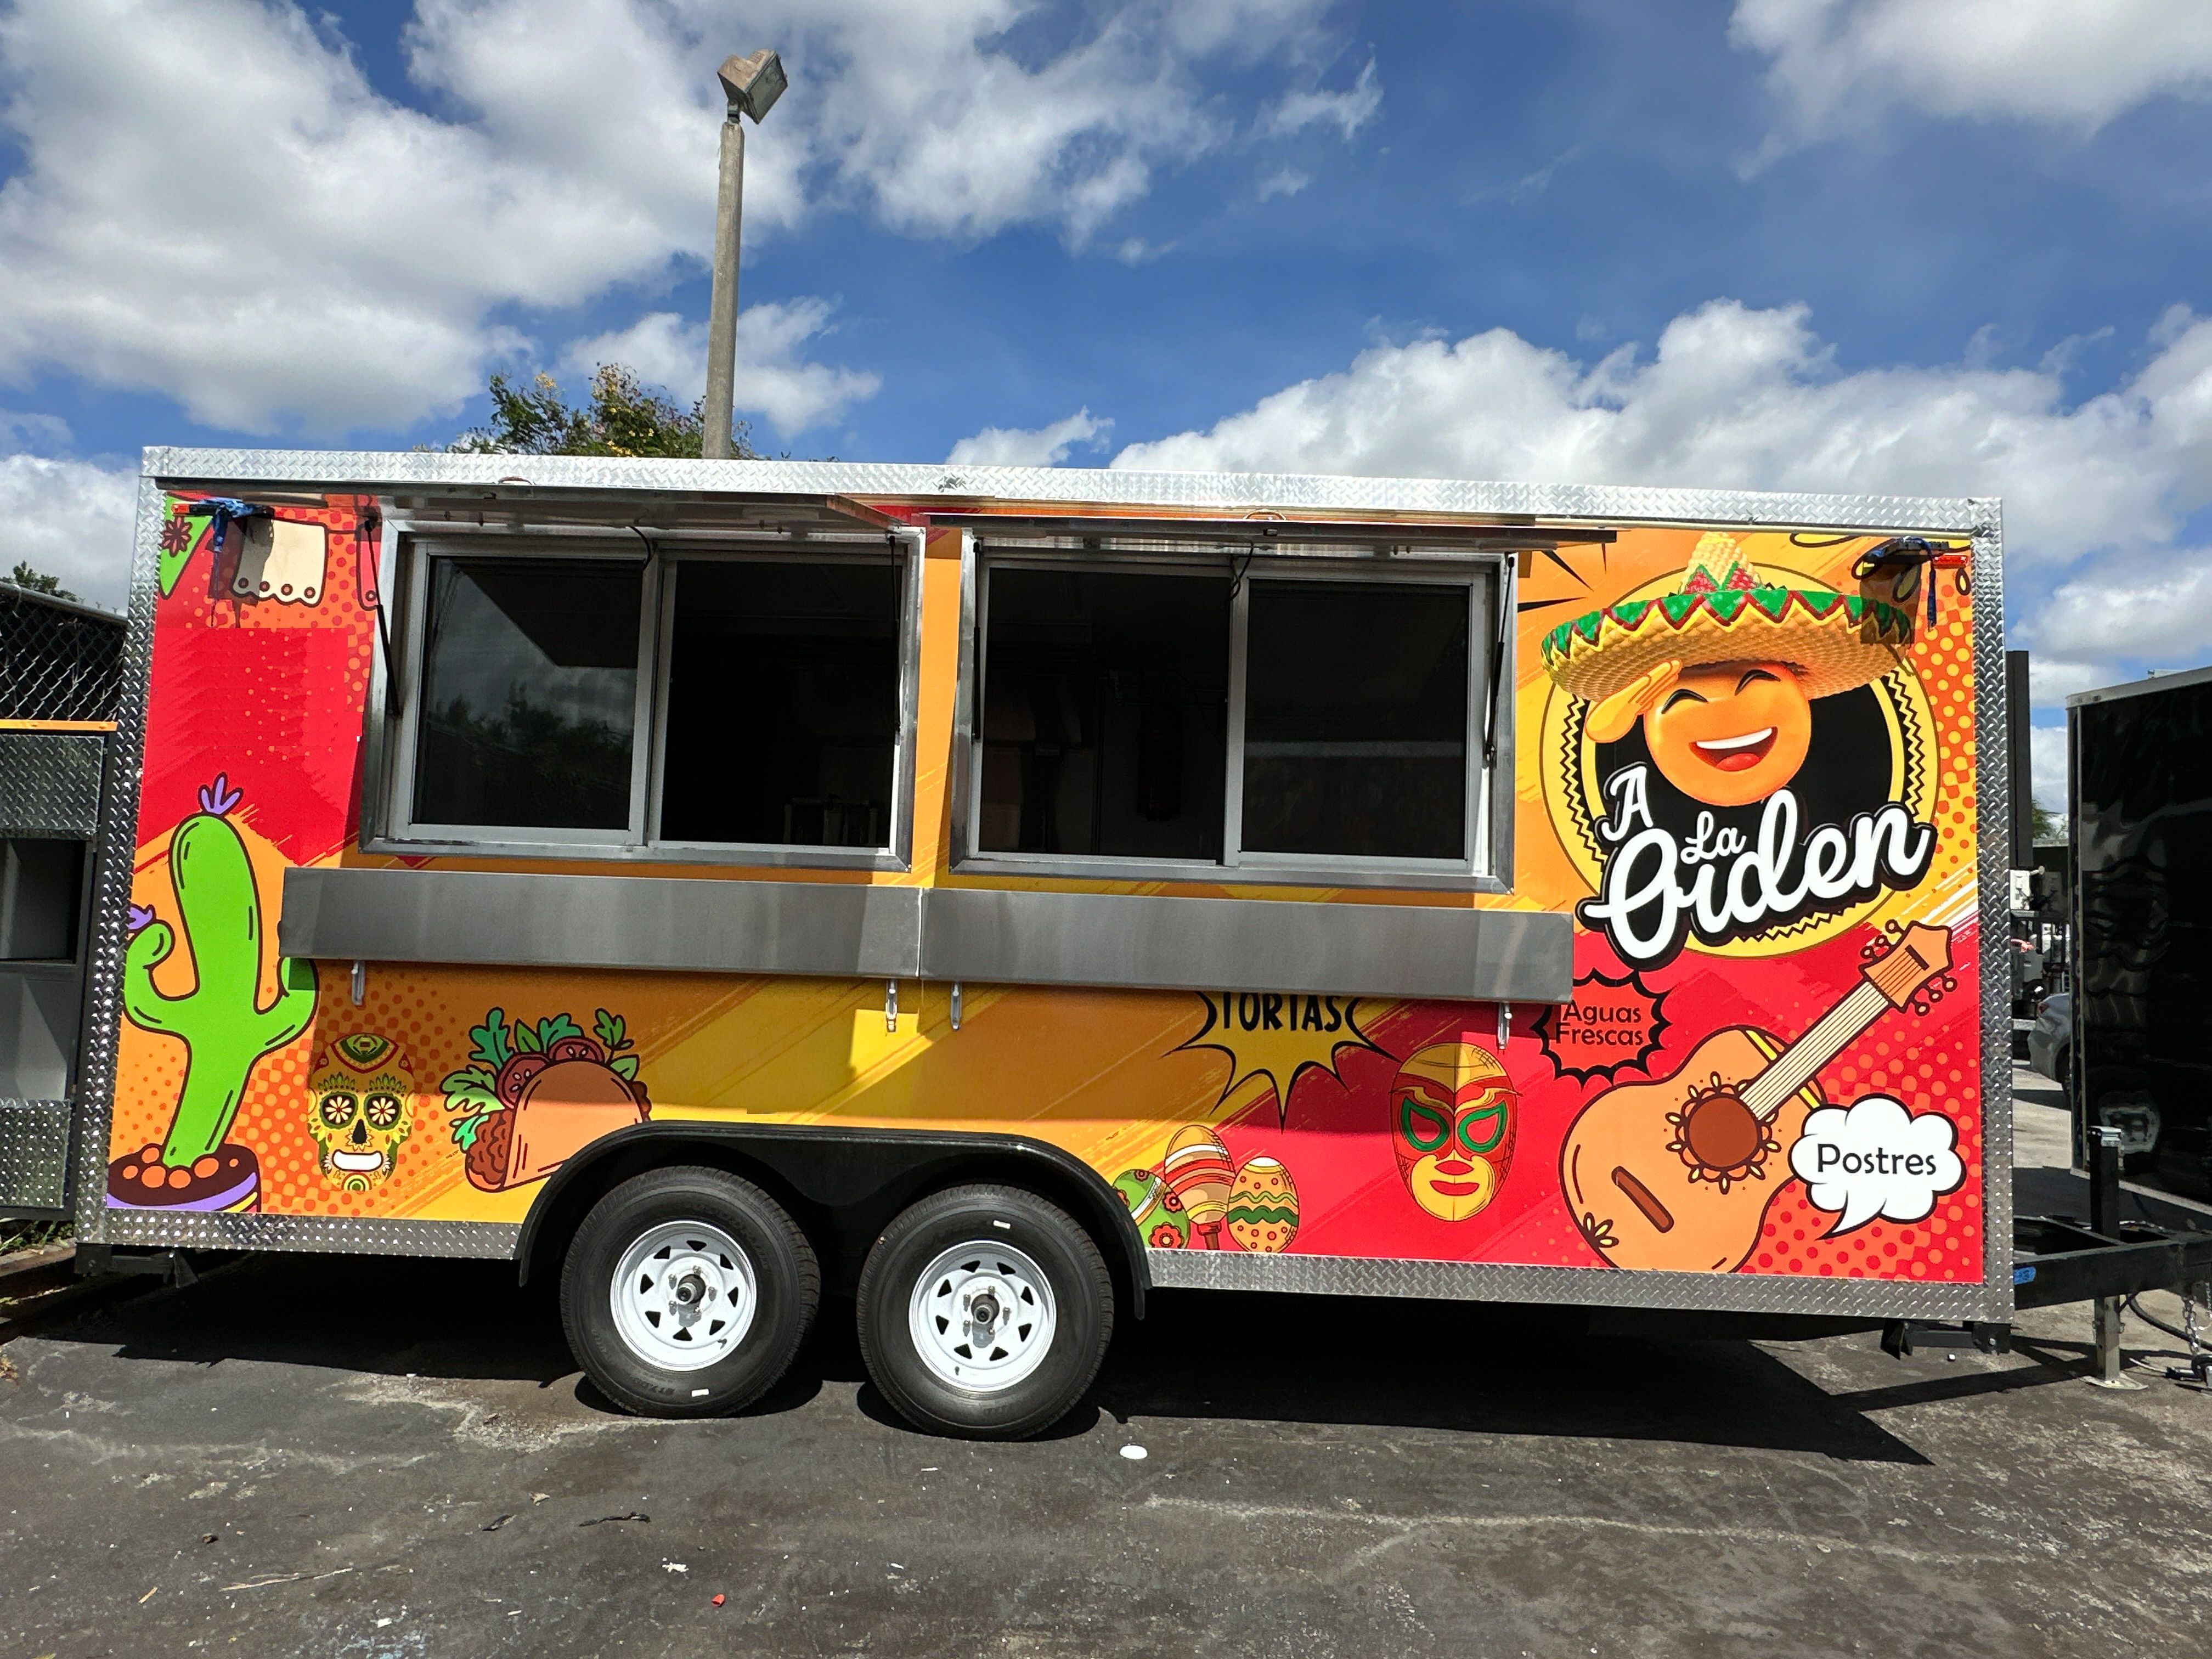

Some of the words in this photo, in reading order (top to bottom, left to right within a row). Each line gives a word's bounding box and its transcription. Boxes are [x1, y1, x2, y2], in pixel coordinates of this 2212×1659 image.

[1601, 766, 1653, 841] A
[1680, 810, 1747, 864] La
[1562, 1000, 1641, 1025] Aguas
[1556, 1022, 1644, 1046] Frescas
[1817, 1143, 1937, 1176] Postres
